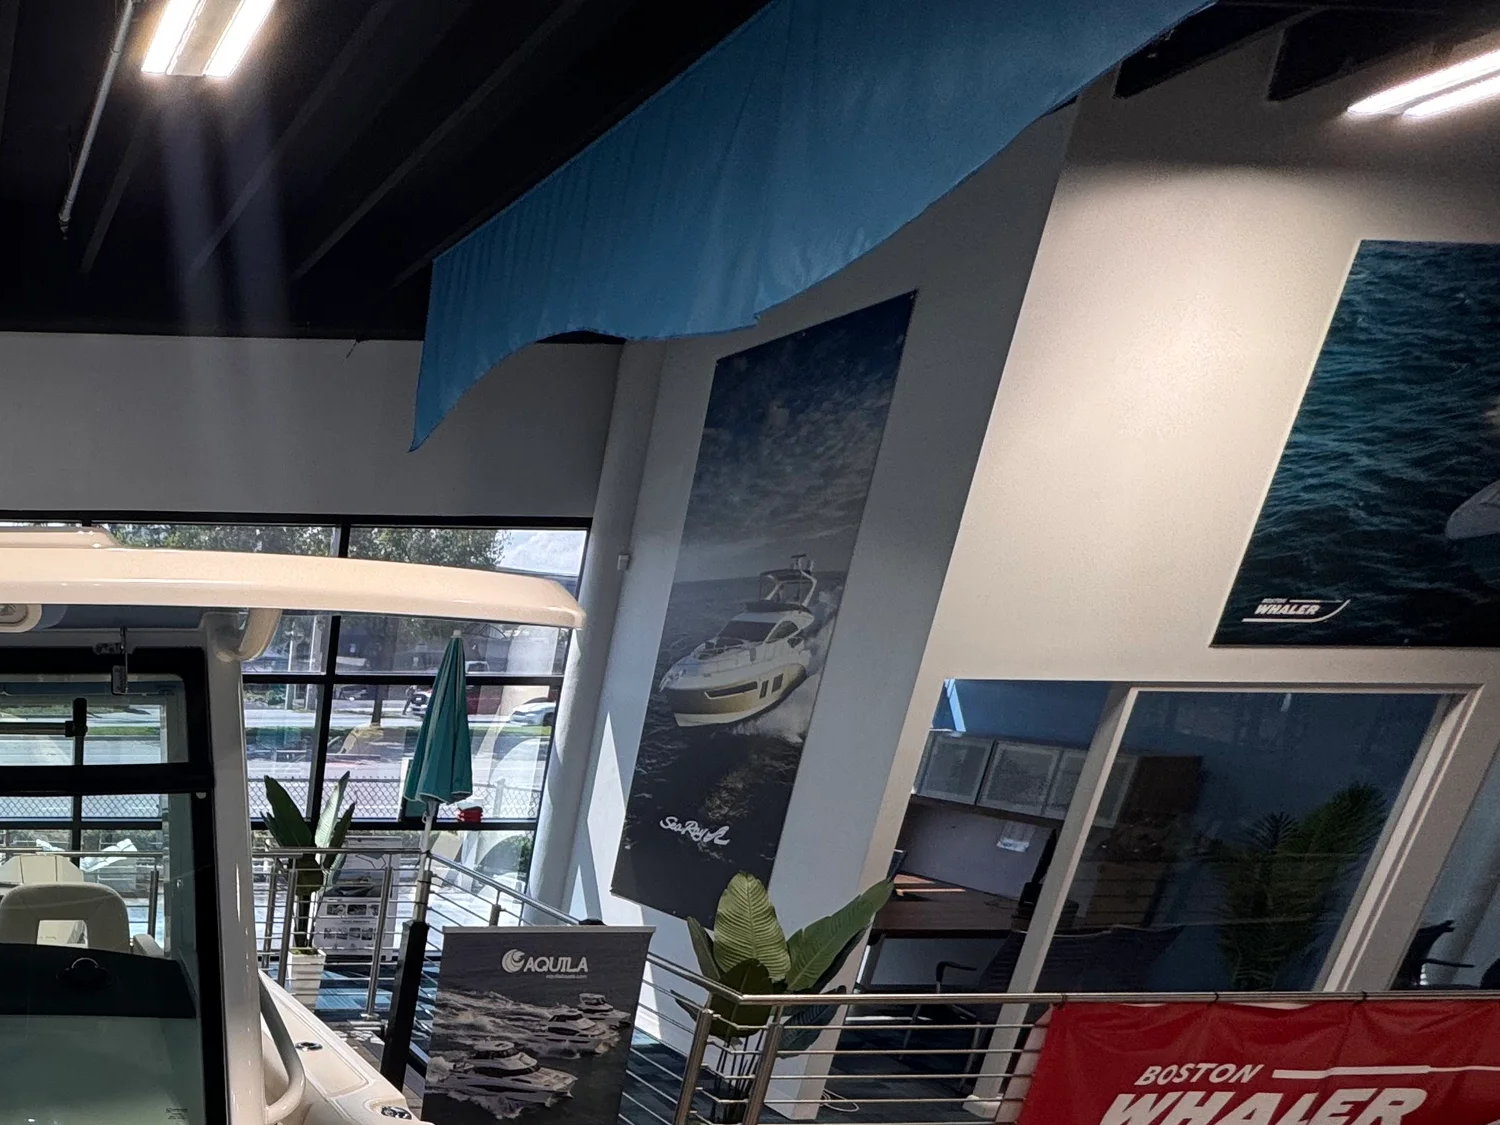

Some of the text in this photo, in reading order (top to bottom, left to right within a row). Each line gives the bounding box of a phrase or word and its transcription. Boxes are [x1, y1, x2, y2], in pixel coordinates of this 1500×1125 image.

[1254, 604, 1321, 615] WHALER
[659, 816, 709, 842] Sea Ray
[523, 956, 589, 973] AQUILA
[1133, 1062, 1265, 1086] BOSTON
